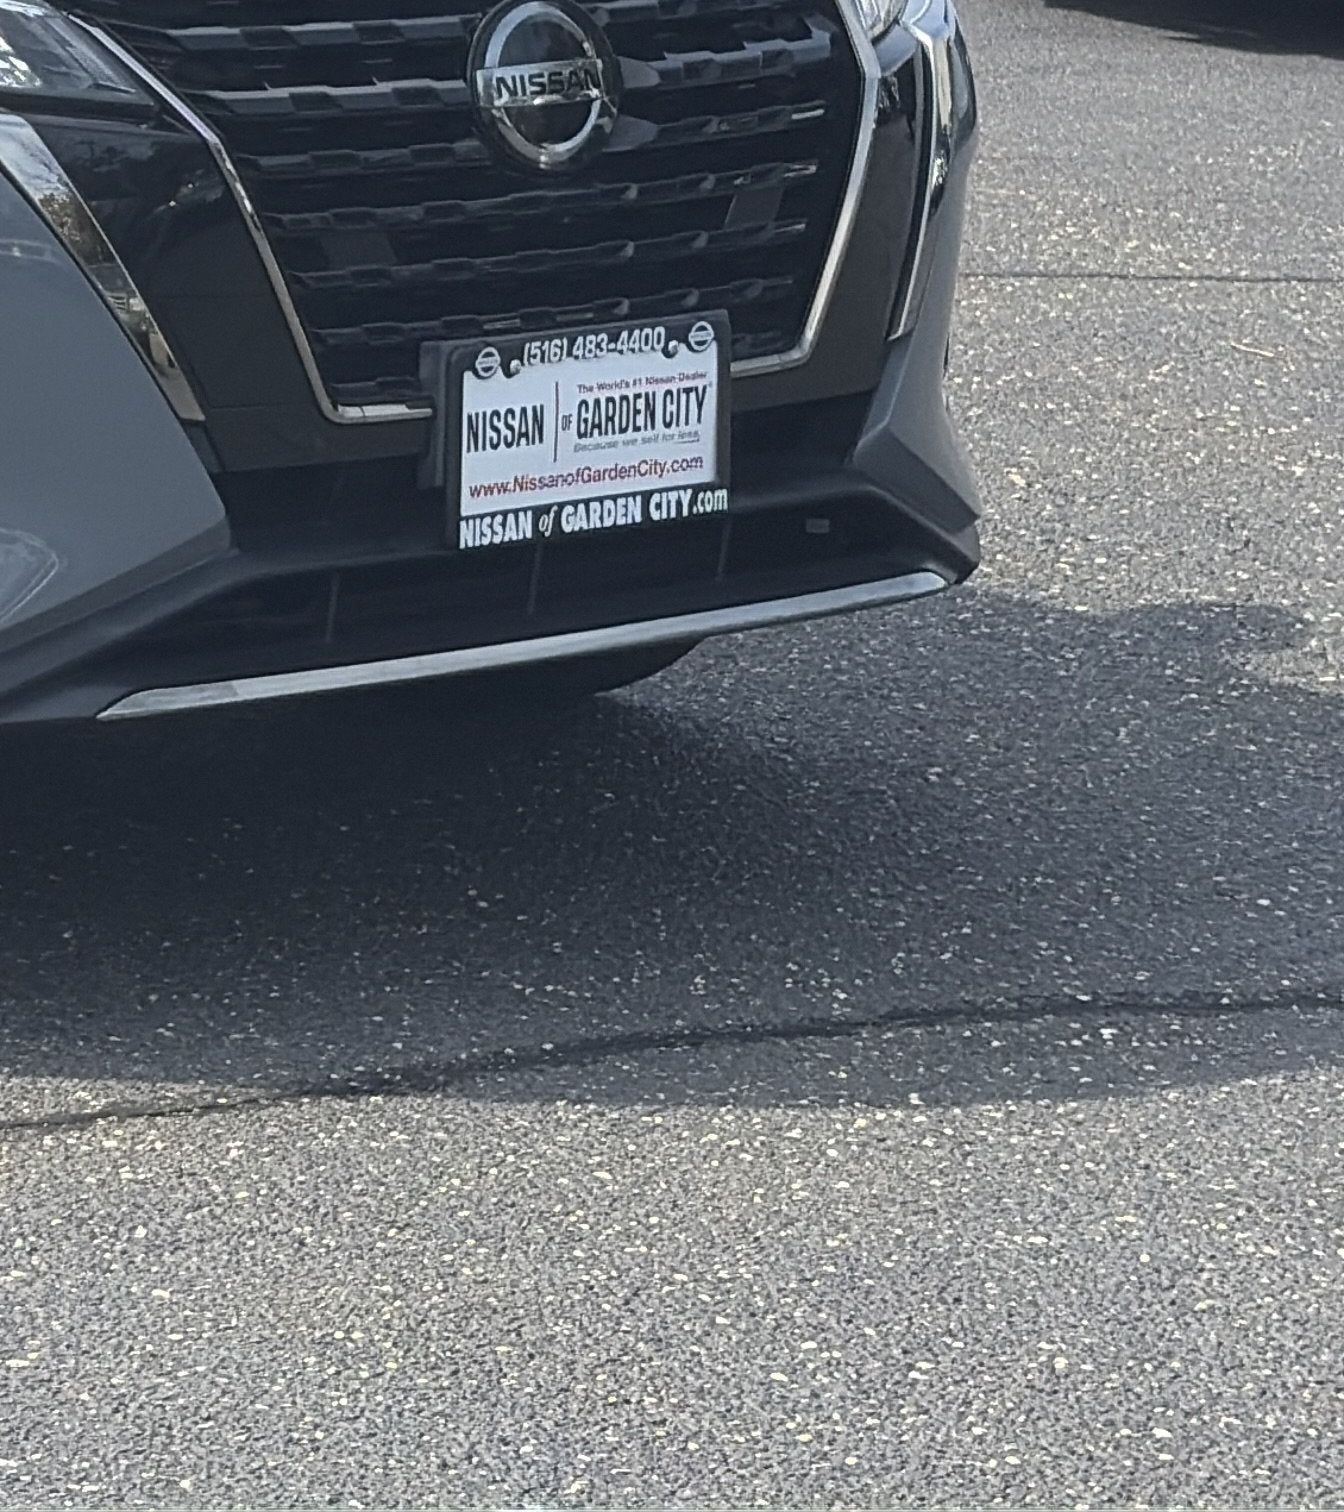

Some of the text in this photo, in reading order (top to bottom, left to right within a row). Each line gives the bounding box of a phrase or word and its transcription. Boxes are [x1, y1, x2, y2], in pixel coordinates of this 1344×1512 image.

[494, 67, 602, 99] NISSAN
[522, 326, 666, 366] (516) 483-4400
[466, 384, 708, 454] NISSAN OF GARDEN CITY
[468, 454, 704, 499] www.NissanofGardenCity.com
[459, 487, 729, 550] NISSAN of GARDEN CITY.com
